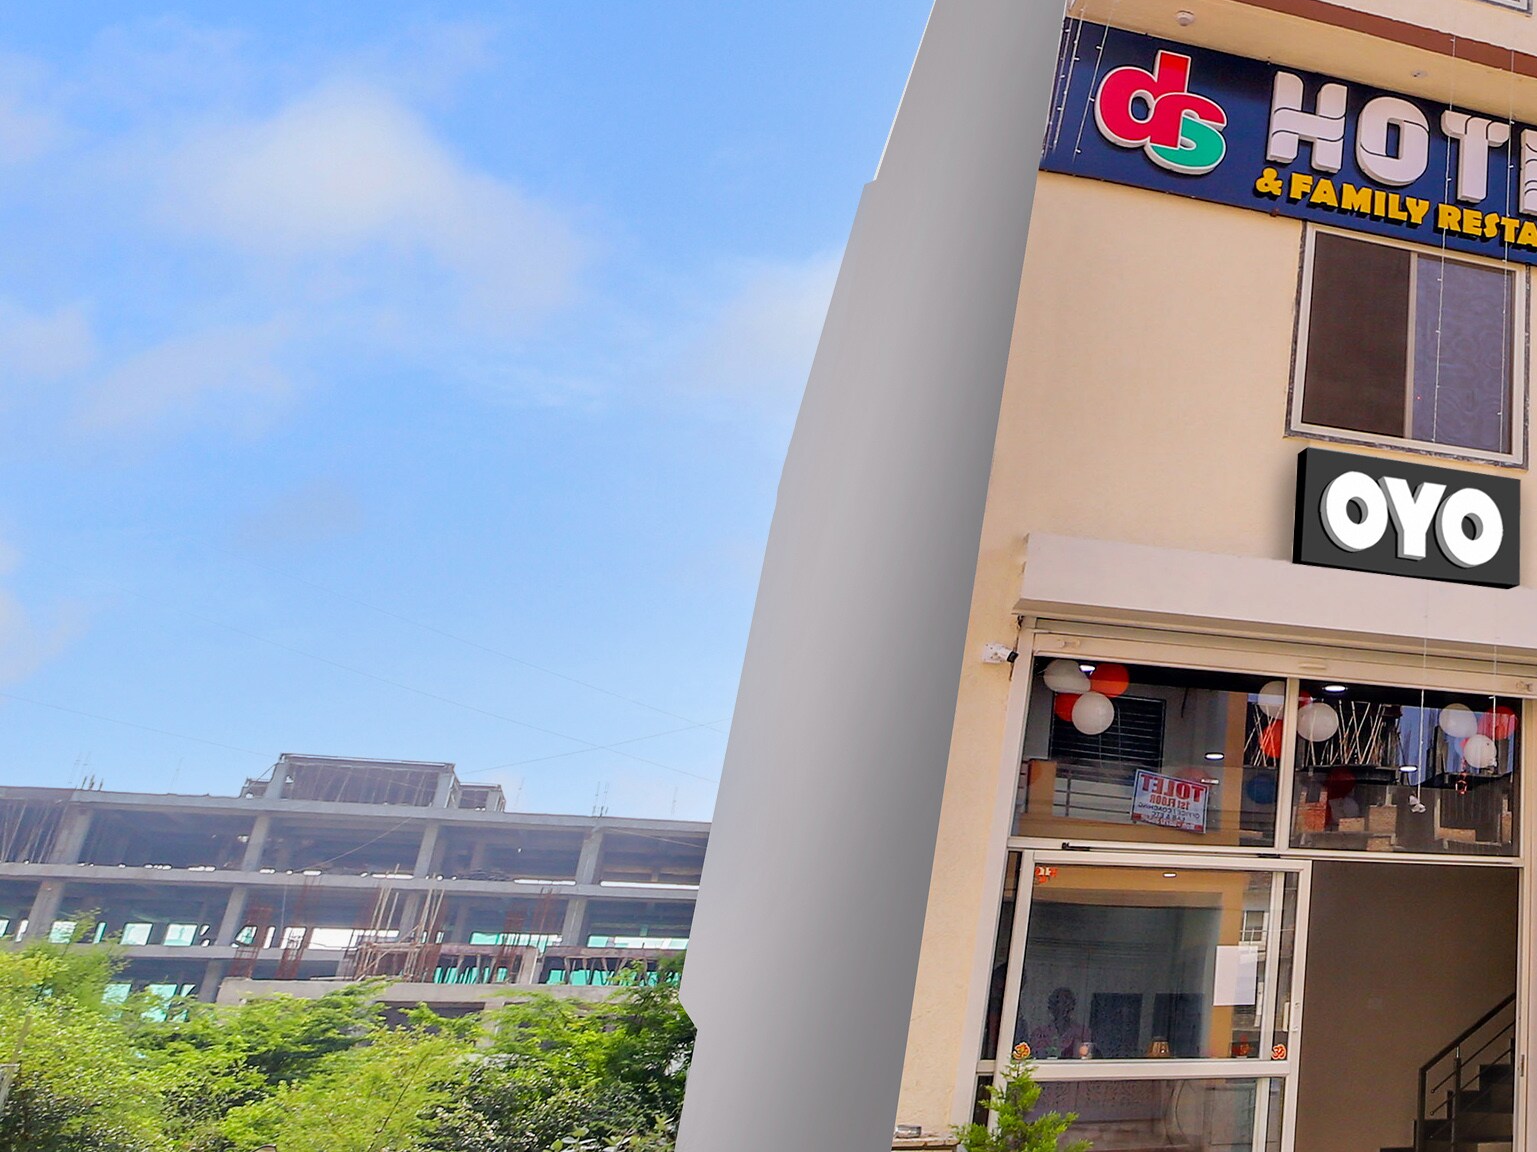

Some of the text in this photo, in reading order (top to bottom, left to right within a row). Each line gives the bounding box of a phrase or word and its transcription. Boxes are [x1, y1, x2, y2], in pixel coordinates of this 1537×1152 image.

[1255, 167, 1283, 198] &
[1289, 173, 1431, 226] FAMILY
[1319, 470, 1504, 569] OYO
